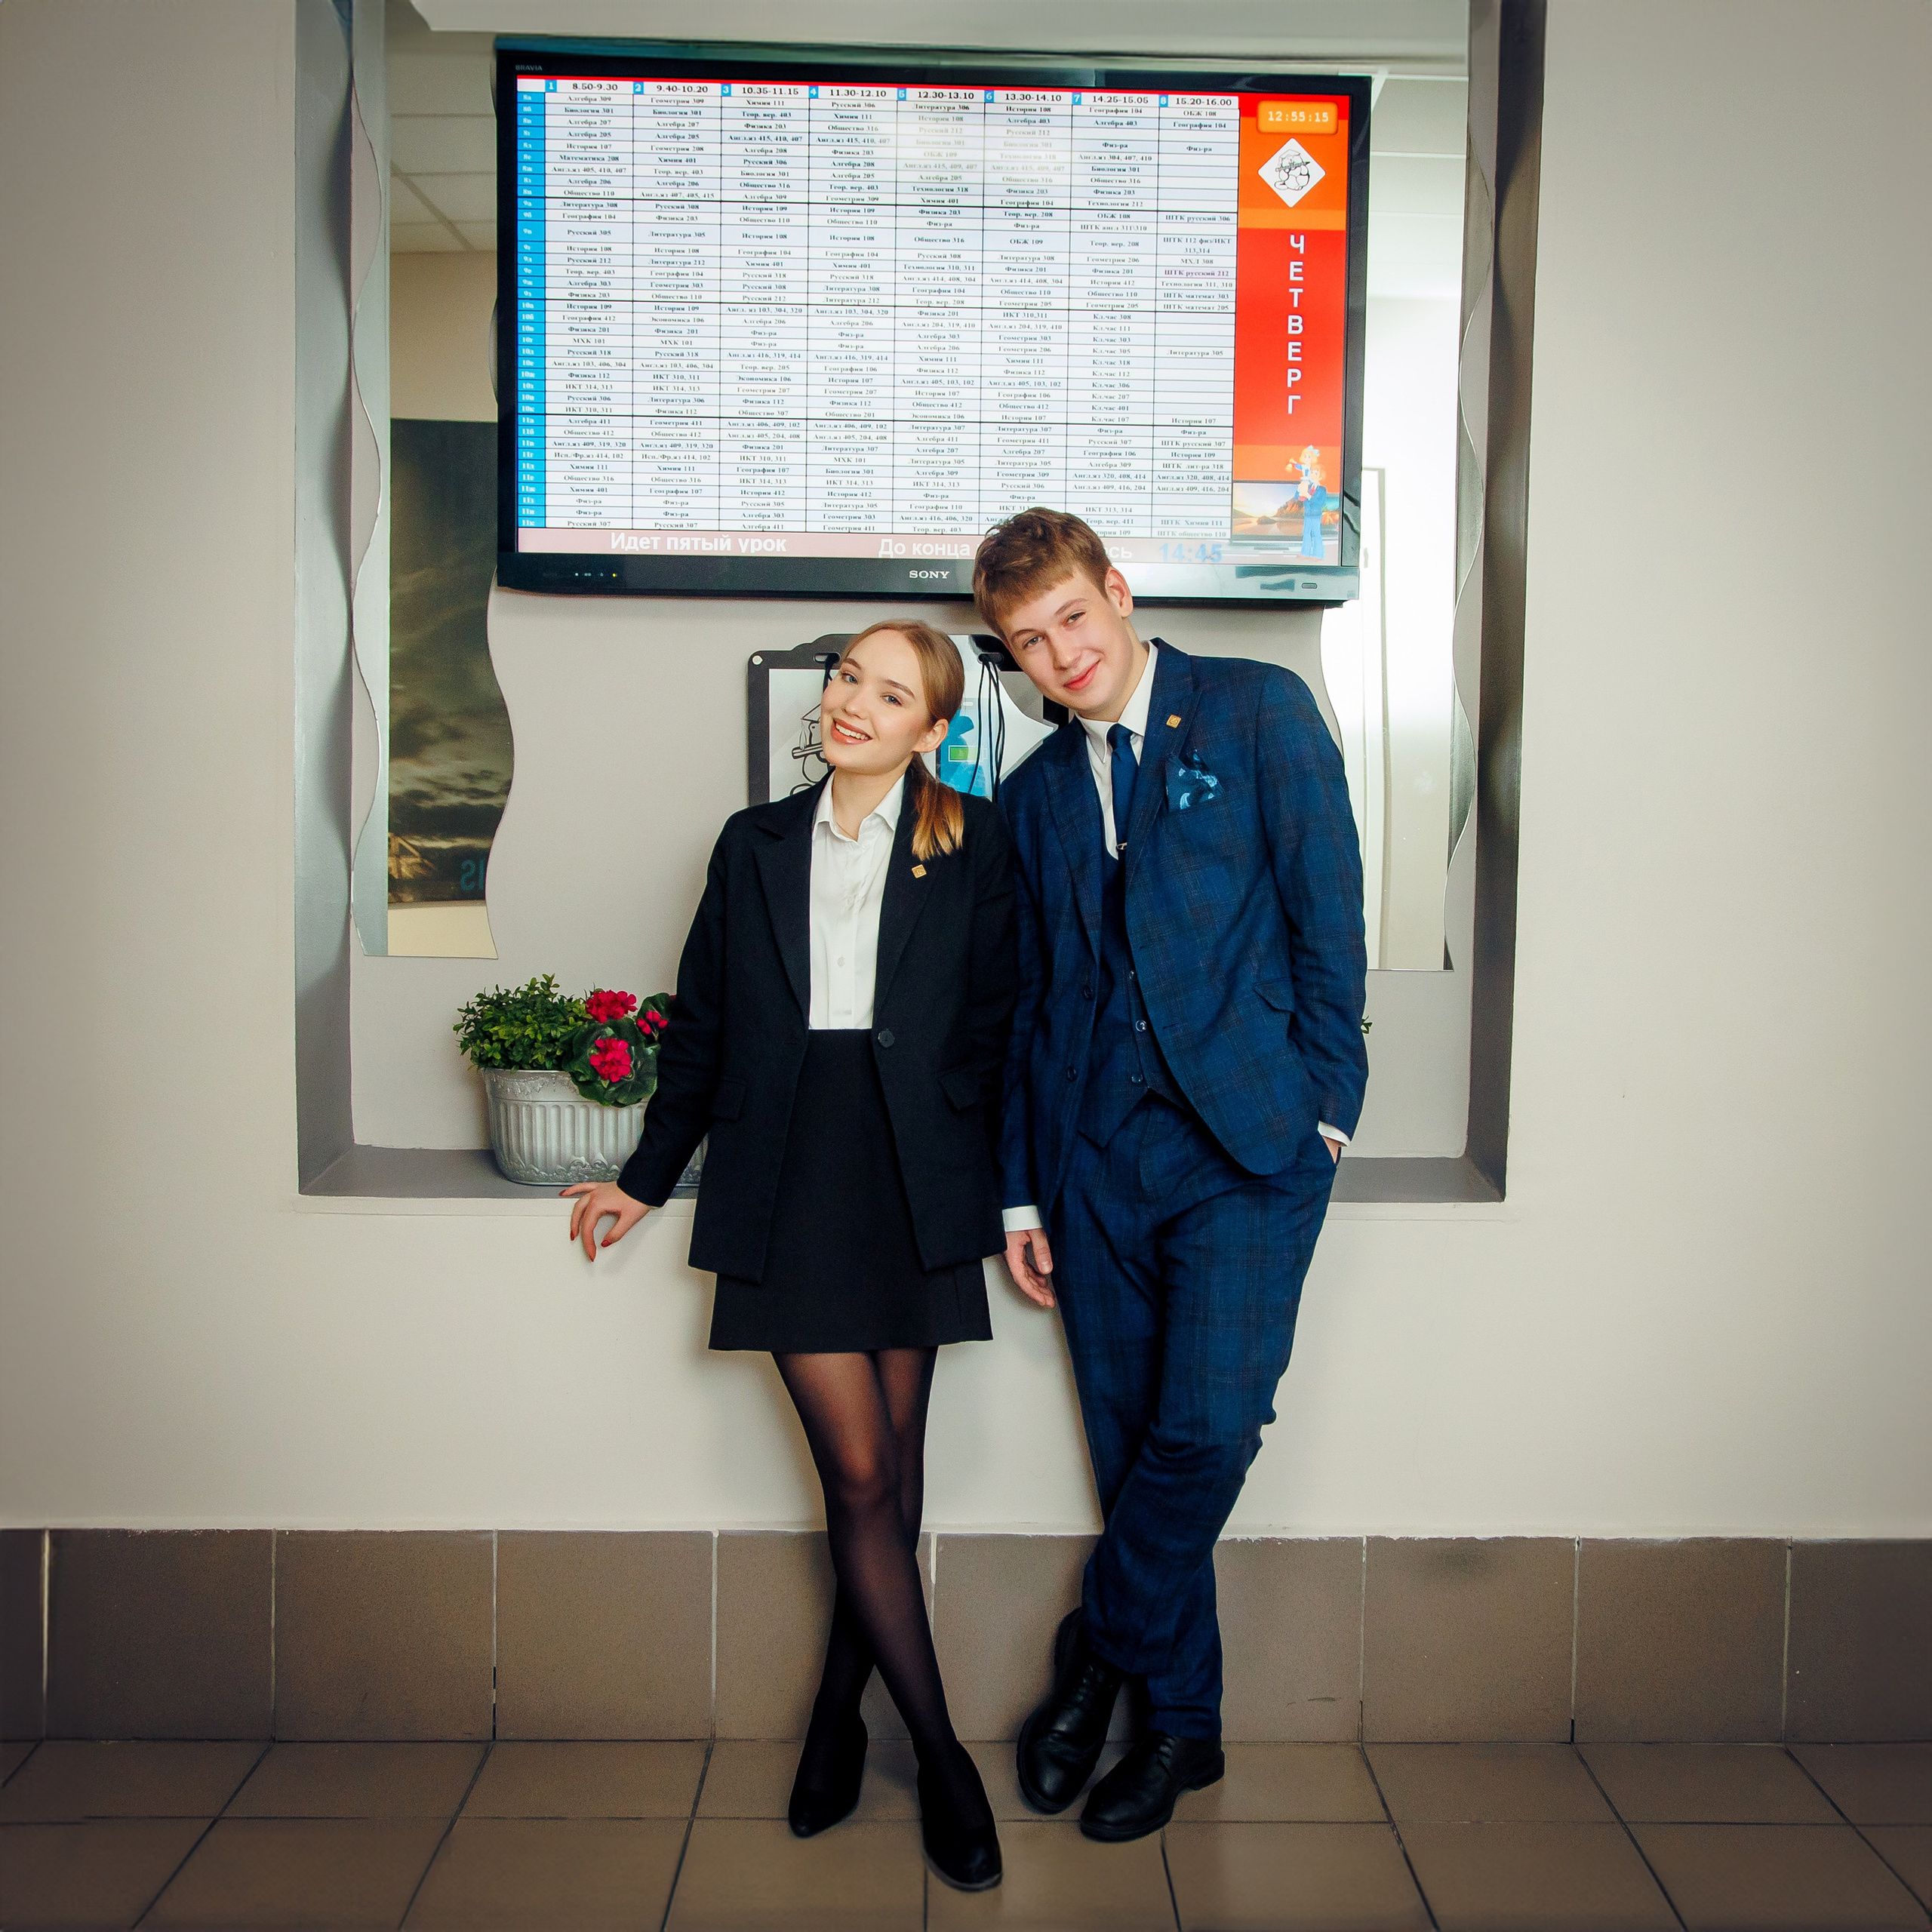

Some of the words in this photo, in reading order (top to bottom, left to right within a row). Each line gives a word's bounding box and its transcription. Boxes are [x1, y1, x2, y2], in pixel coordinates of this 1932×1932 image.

[548, 82, 554, 90] 1
[572, 82, 618, 91] 8.50-9.30
[635, 84, 641, 92] 2
[656, 85, 708, 94] 9.40-10.20
[723, 85, 729, 94] 3
[742, 87, 799, 95] 10.35-11.15
[810, 88, 817, 96] 4
[830, 88, 887, 97] 11.30-12.10
[899, 90, 905, 98] 5
[918, 91, 974, 100] 12.30-13.10
[986, 92, 992, 100] 6
[1005, 93, 1062, 102] 13.30-14.10
[1074, 94, 1080, 103] 7
[1092, 95, 1149, 104] 14.25-15.05
[1160, 97, 1167, 105] 8
[1176, 97, 1232, 106] 15.20-16.00
[1268, 111, 1329, 122] 12:55:15
[1287, 235, 1305, 414] ЧЕТВЕРГ
[611, 532, 661, 552] Идет
[666, 534, 731, 552] пятый
[738, 538, 787, 553] урок
[878, 539, 906, 558] До
[912, 543, 971, 558] конца
[1159, 543, 1223, 563] 14:45
[909, 570, 950, 579] SONY
